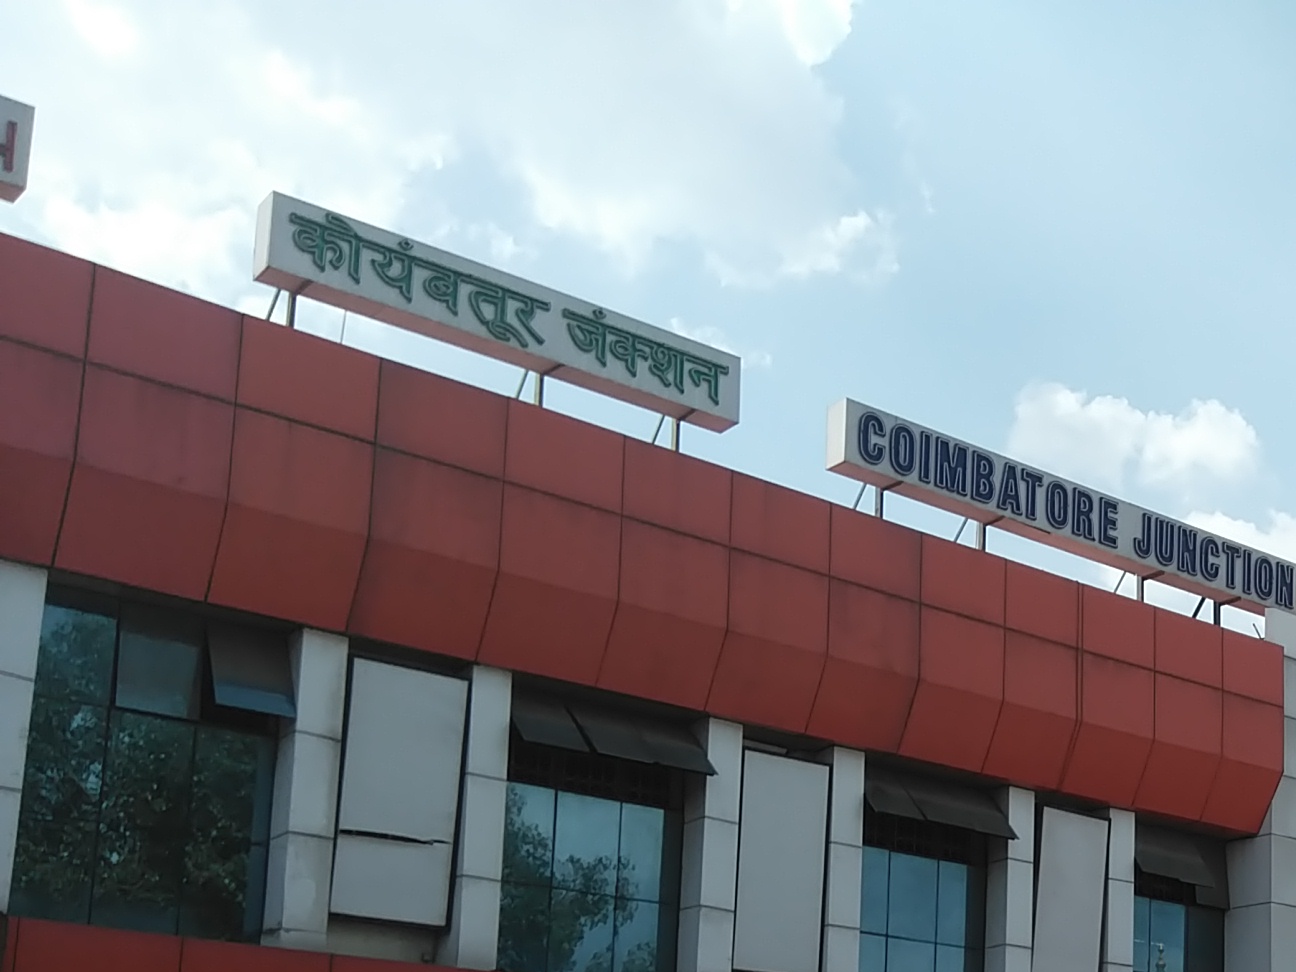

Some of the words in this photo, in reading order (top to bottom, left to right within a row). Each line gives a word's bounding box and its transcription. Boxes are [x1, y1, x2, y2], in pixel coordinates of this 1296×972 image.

[562, 307, 729, 406] जंक्शन
[858, 412, 1119, 549] COIMBATORE
[1134, 512, 1296, 610] JUNCTION
